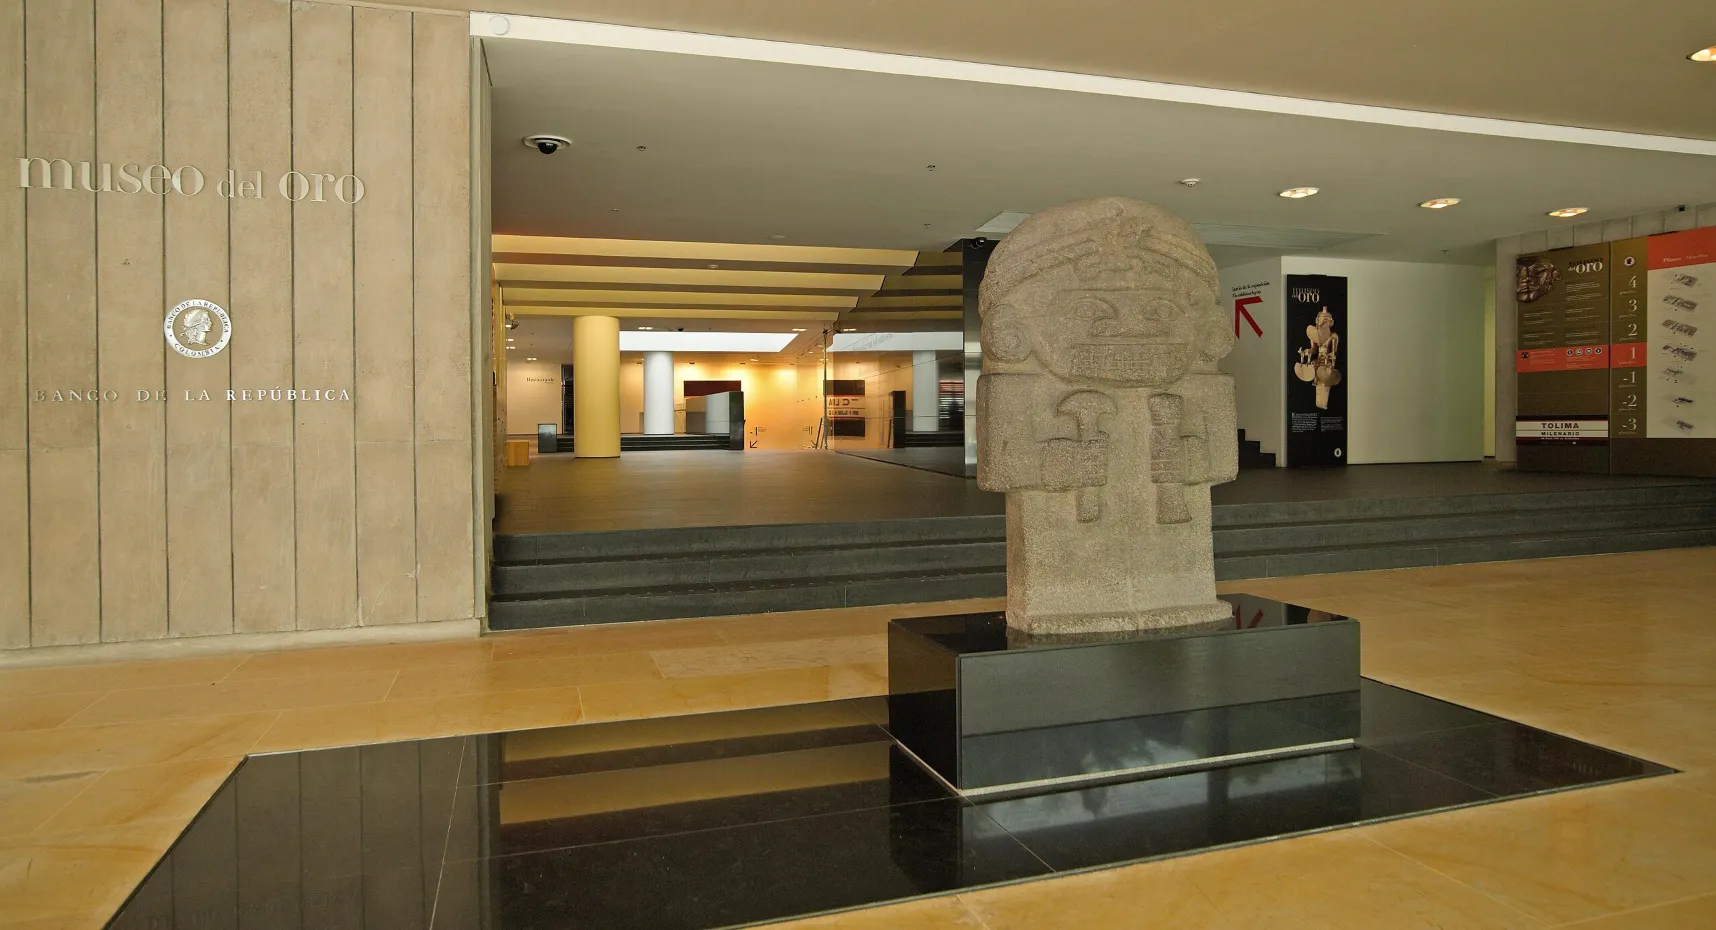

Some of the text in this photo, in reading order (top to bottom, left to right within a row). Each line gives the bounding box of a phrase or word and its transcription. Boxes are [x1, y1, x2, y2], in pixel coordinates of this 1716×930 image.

[16, 157, 365, 204] museo del oro
[1575, 261, 1603, 274] oro
[1628, 275, 1637, 288] 4
[1298, 292, 1320, 303] oro
[1628, 299, 1637, 312] 3
[167, 307, 181, 329] BANCO
[1628, 323, 1638, 336] 2
[174, 343, 220, 357] COLOMBIA
[1630, 347, 1636, 360] 1
[1622, 370, 1637, 384] -1
[34, 386, 350, 402] BANCO DE LA REPÚBLICA
[1622, 394, 1637, 408] -2
[1622, 418, 1637, 431] -3
